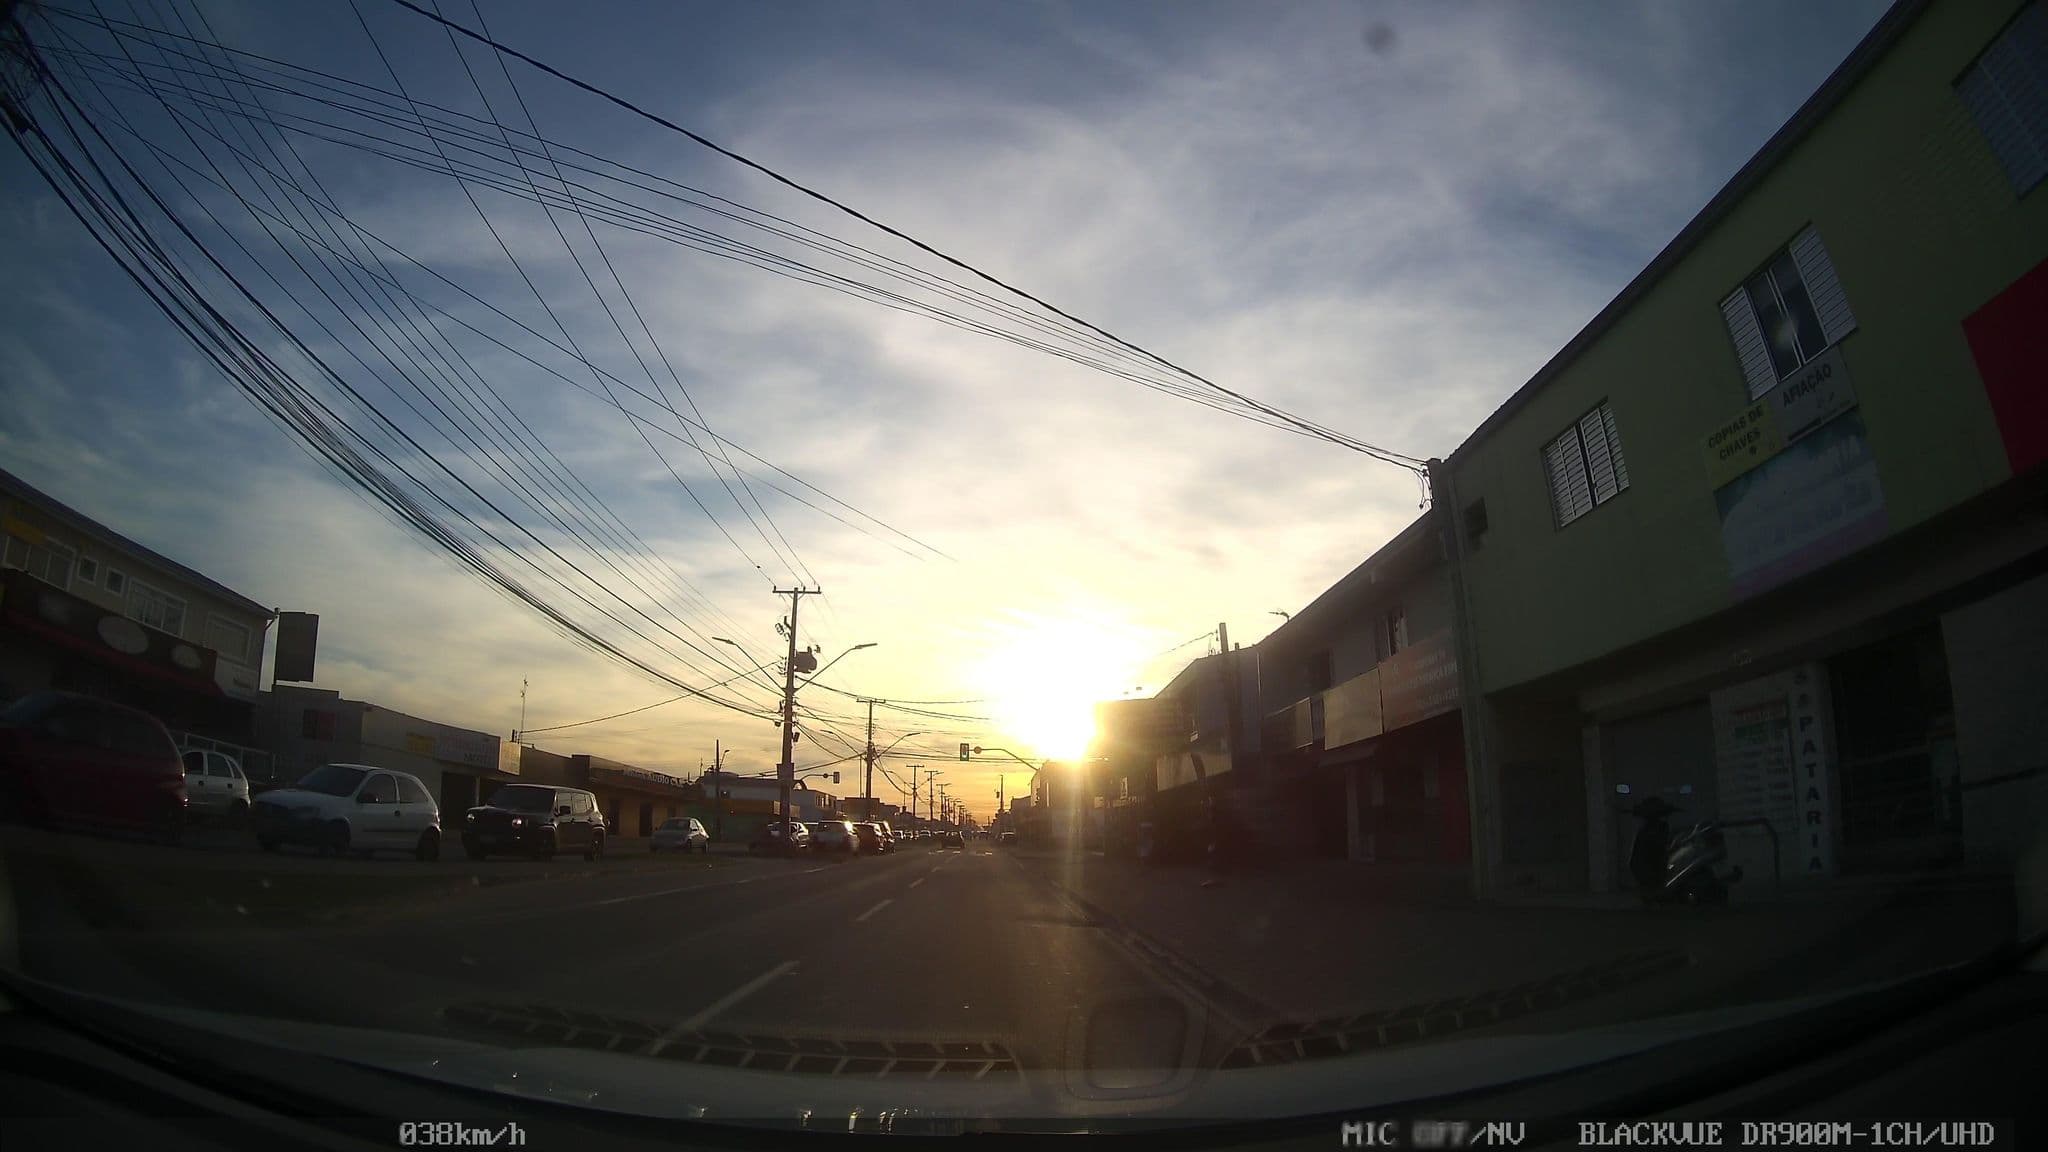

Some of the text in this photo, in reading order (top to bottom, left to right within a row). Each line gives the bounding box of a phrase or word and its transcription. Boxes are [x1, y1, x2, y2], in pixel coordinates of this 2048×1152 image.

[1782, 363, 1832, 408] AFIAÇÃO
[1748, 404, 1765, 423] DE
[1719, 427, 1761, 461] CHAVES
